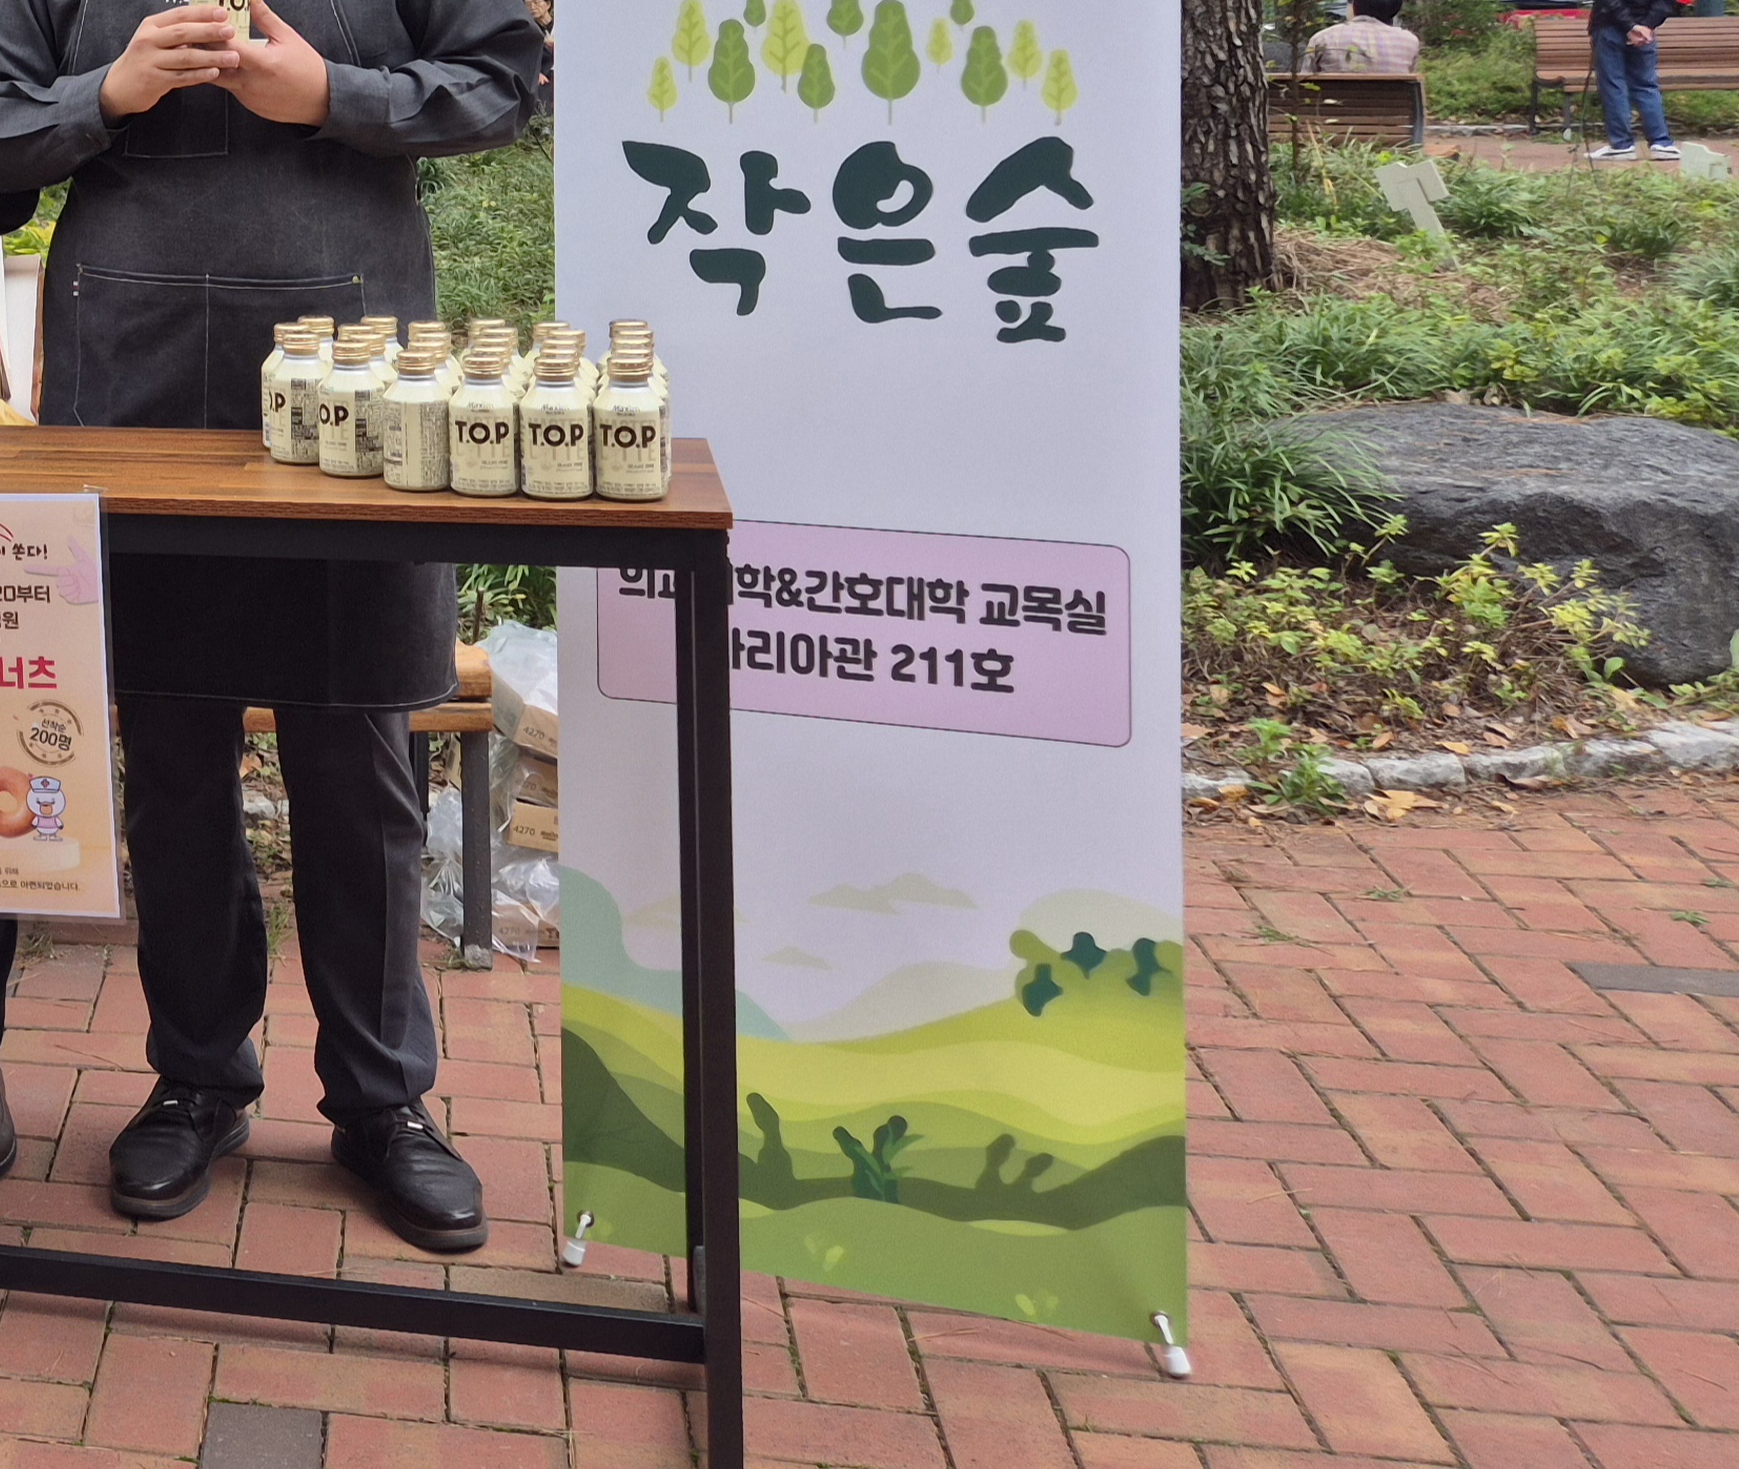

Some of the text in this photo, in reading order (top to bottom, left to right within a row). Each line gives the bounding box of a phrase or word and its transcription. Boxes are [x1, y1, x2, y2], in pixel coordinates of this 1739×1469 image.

[622, 137, 1099, 343] 작은숲
[455, 421, 509, 444] T.O.P
[529, 423, 584, 447] T.O.P
[599, 424, 656, 448] T.O.P
[12, 544, 48, 560] 쏜다!
[618, 564, 1107, 636] 의학&간호대학 교목실
[890, 644, 1015, 694] 211호
[42, 718, 66, 733] 선착순
[524, 726, 545, 739] 4270
[30, 728, 72, 751] 200명
[513, 825, 535, 835] 4270
[5, 867, 19, 875] 위해
